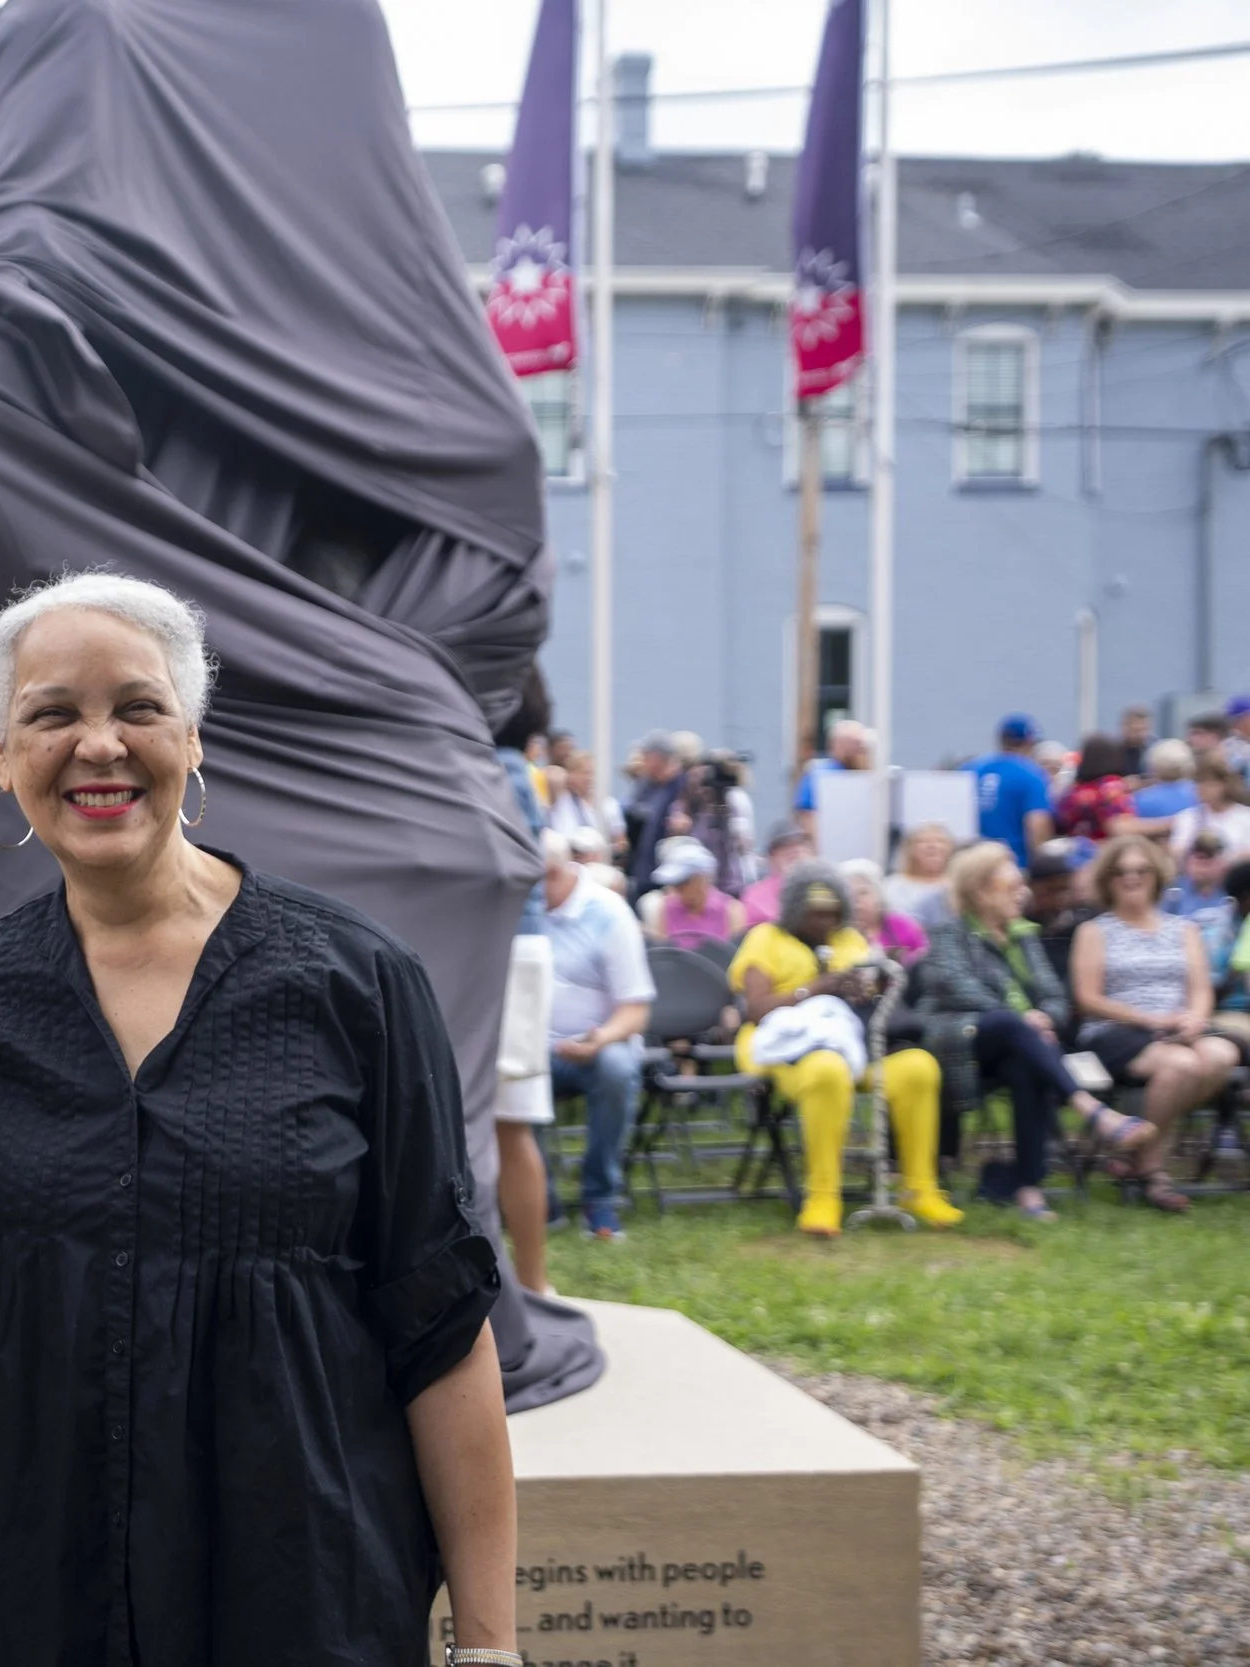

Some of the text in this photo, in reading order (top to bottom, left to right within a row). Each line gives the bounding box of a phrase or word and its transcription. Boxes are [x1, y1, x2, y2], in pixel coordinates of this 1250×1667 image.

[516, 1550, 766, 1591] egins with people
[538, 1600, 753, 1635] and wanting to
